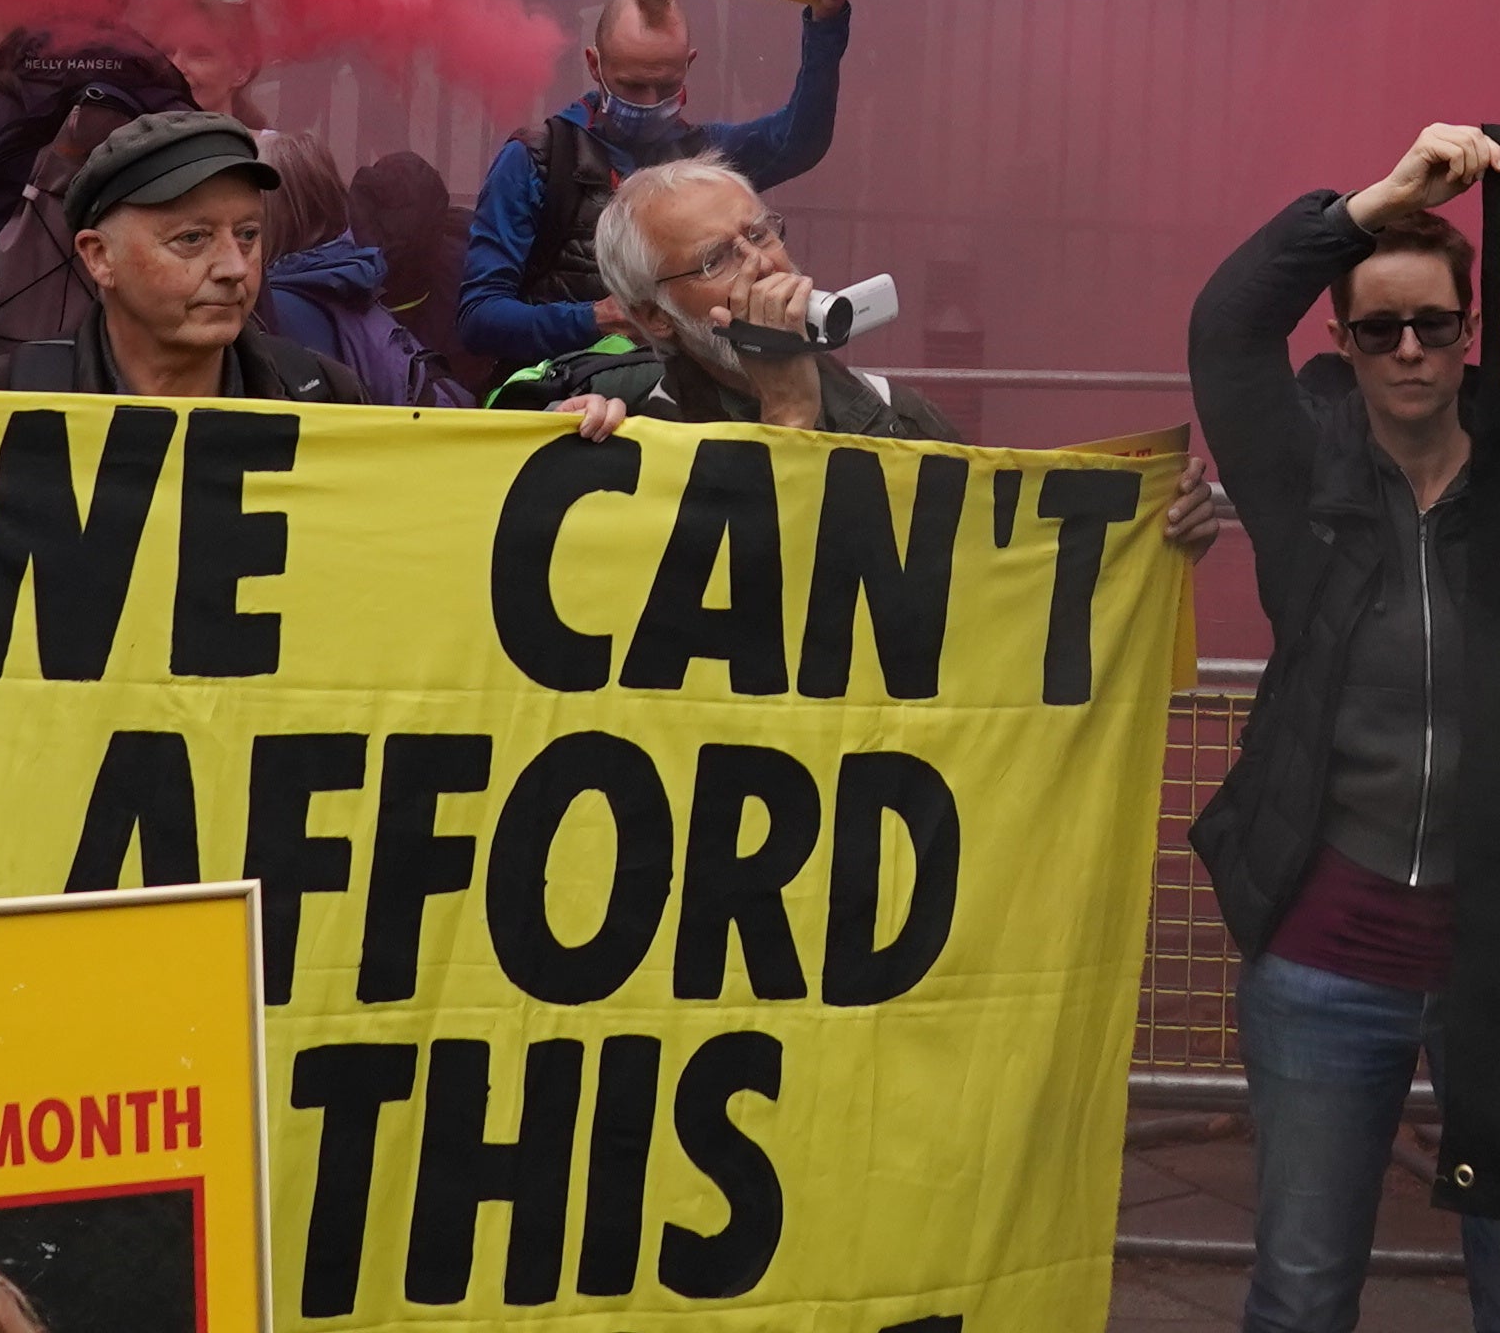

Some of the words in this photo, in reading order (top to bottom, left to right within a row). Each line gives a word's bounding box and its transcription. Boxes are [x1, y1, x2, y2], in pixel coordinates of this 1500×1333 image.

[25, 58, 63, 70] HELLY
[67, 58, 123, 70] HANSEN
[492, 432, 1143, 706] CAN'T
[64, 730, 961, 1007] AFFORD
[290, 1031, 784, 1319] THIS
